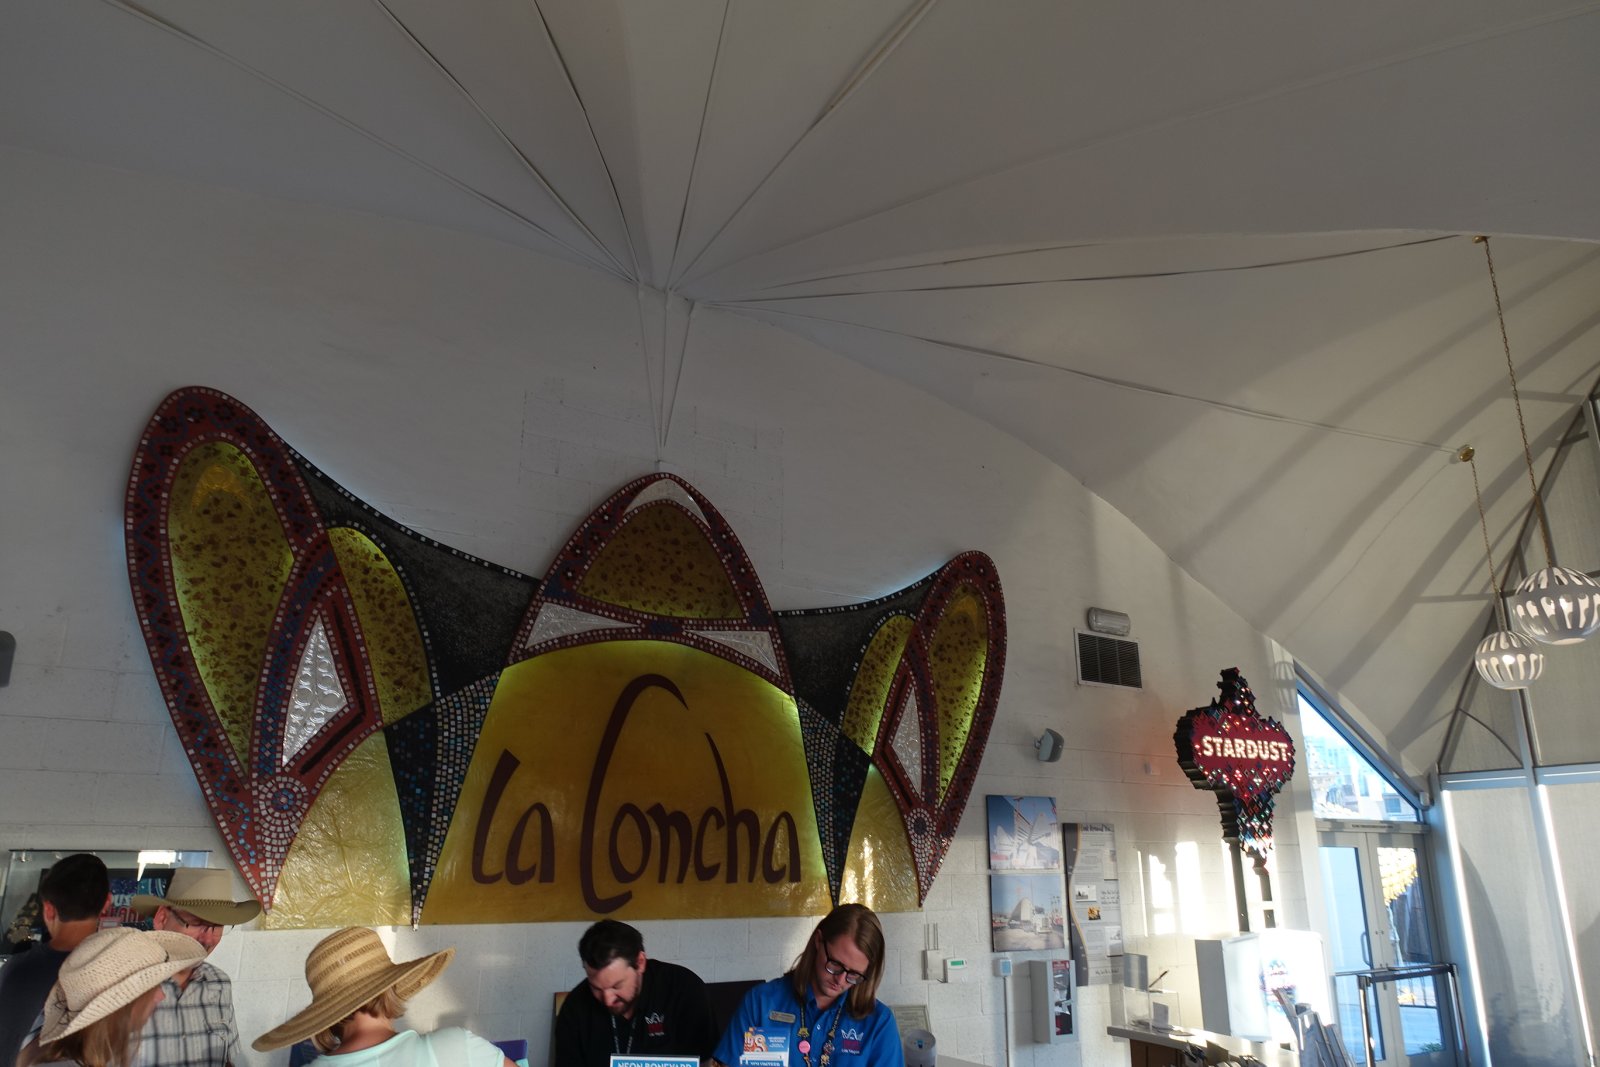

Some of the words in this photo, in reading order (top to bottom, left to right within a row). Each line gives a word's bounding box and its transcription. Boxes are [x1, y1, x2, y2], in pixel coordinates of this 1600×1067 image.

[471, 748, 555, 885] La
[579, 673, 802, 914] Concha
[1202, 735, 1288, 762] STARDUST
